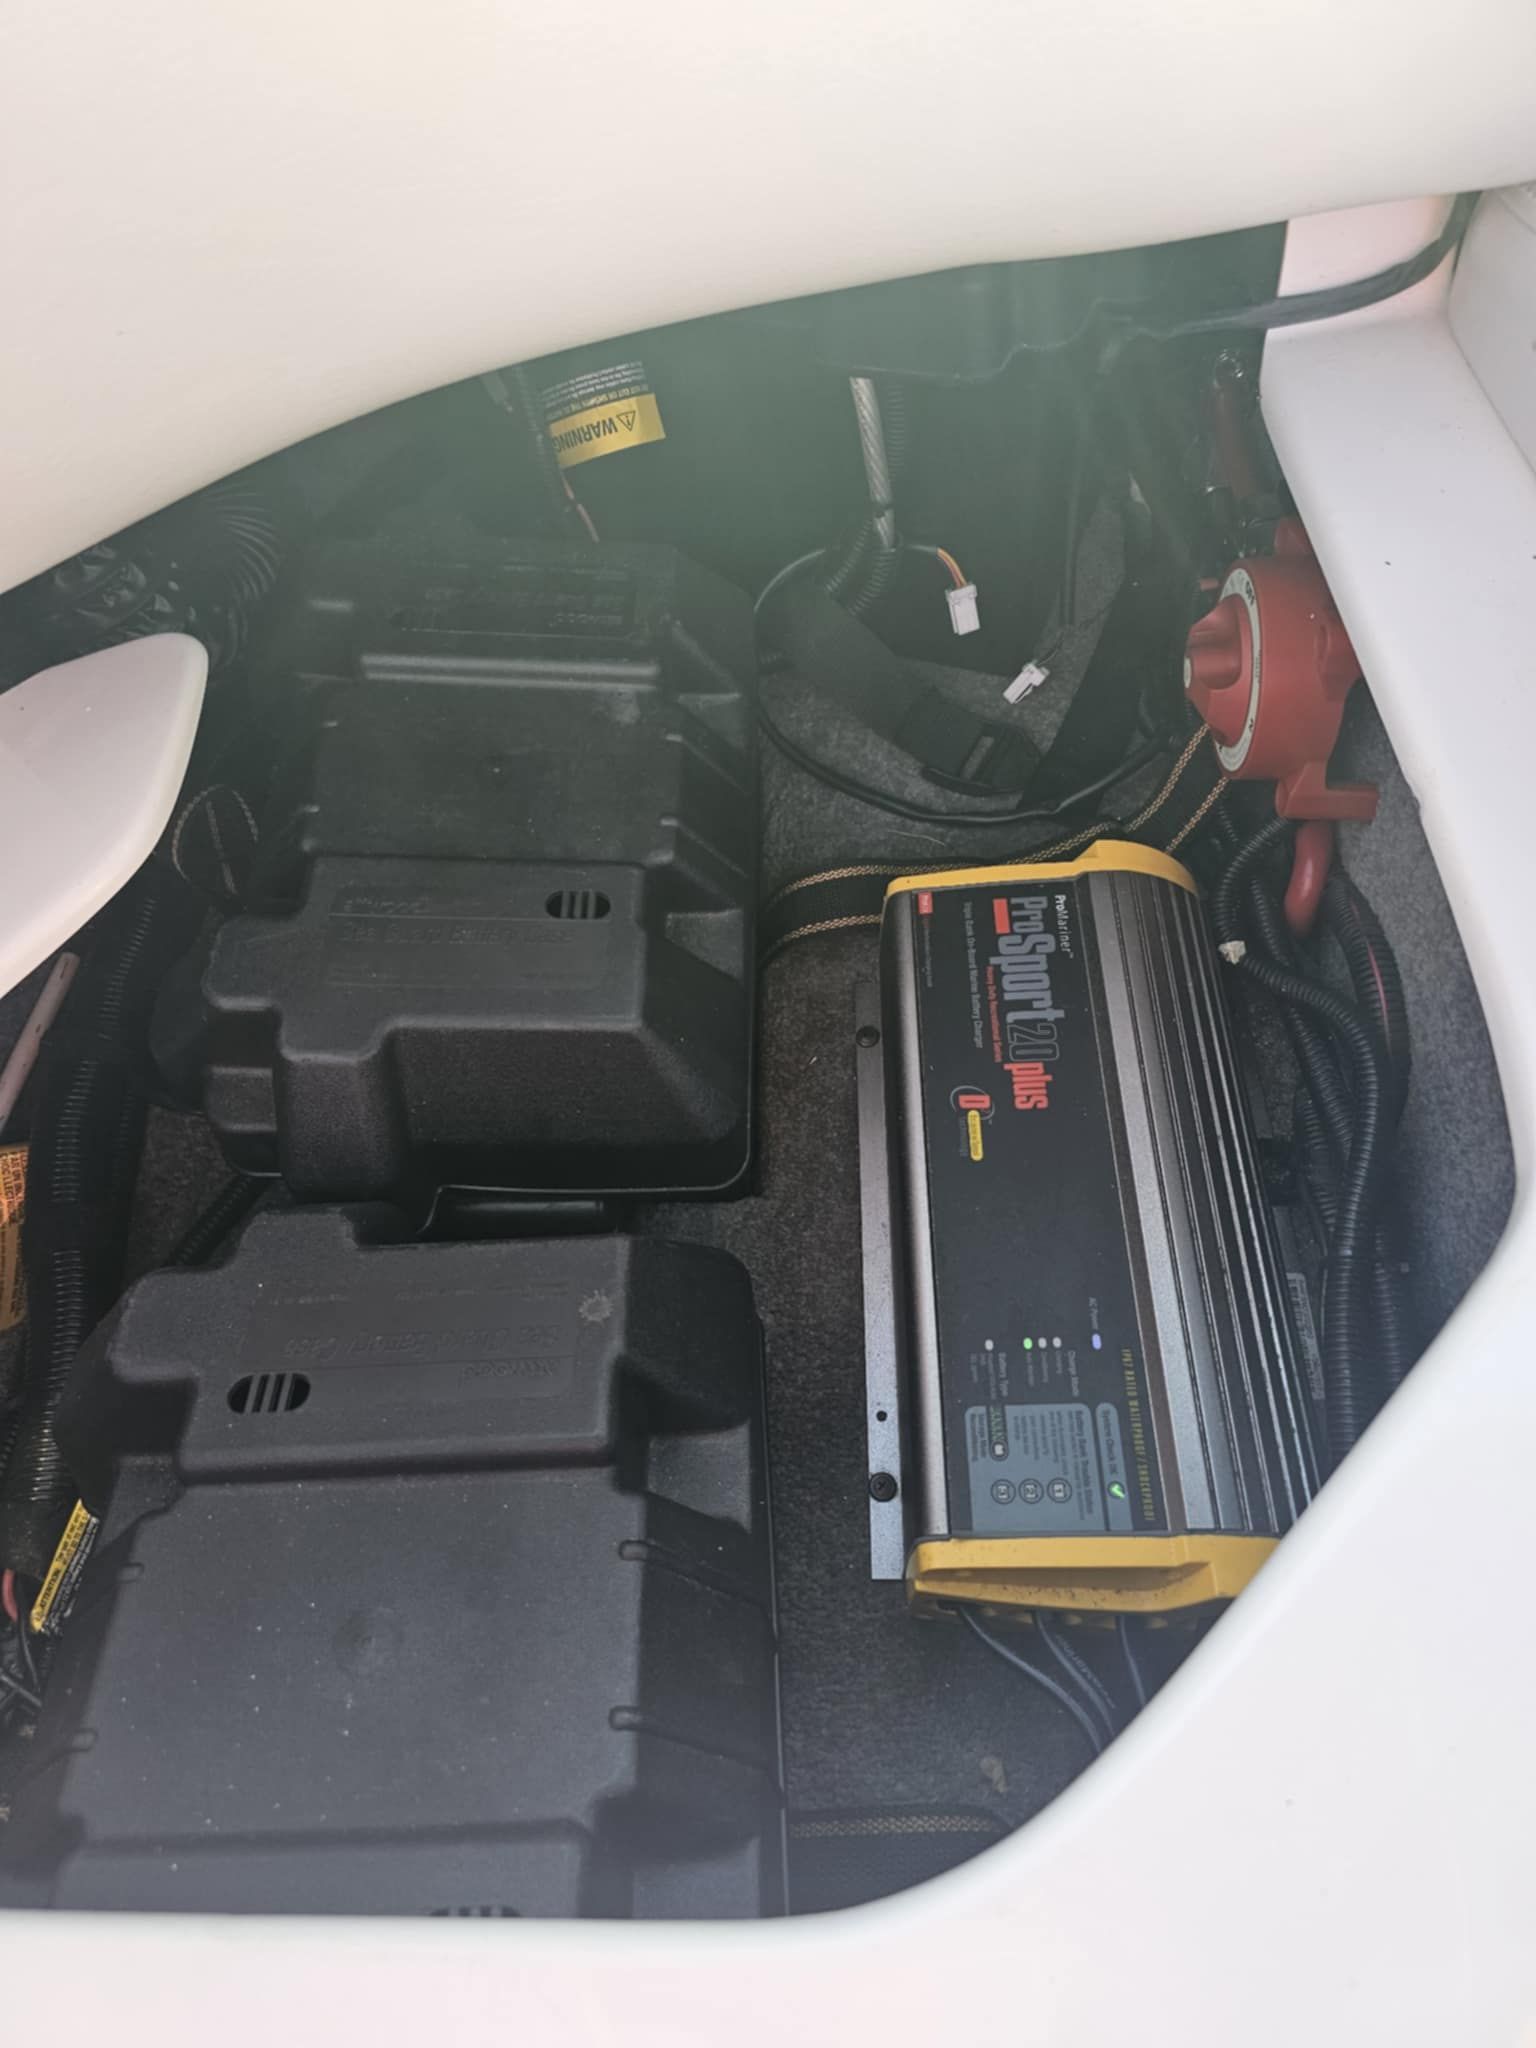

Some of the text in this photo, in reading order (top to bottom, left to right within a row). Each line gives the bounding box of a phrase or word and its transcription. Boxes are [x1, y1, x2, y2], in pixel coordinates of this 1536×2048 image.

[551, 417, 618, 453] WARNING
[971, 994, 981, 1019] Battery
[973, 1020, 983, 1048] Charger
[1124, 1370, 1137, 1396] RATED
